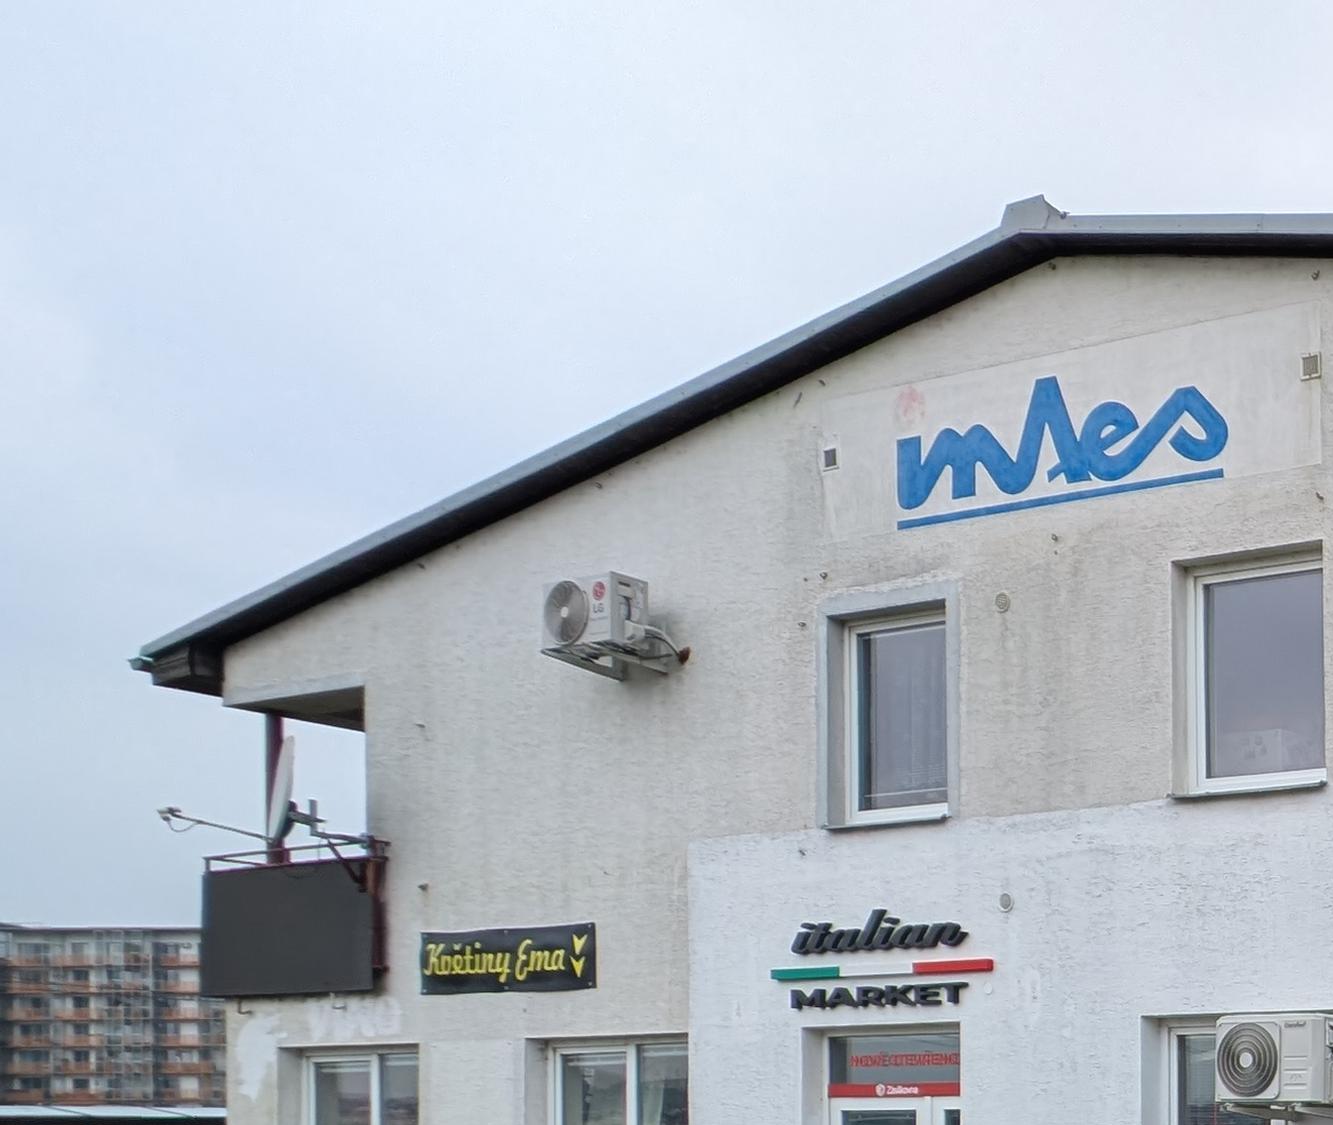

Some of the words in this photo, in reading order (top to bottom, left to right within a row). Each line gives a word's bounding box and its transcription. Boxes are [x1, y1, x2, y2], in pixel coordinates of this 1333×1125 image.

[592, 603, 605, 613] LG
[791, 908, 969, 955] italian
[424, 941, 511, 983] Květiny
[514, 939, 566, 981] Ema
[790, 982, 969, 1010] MARKET
